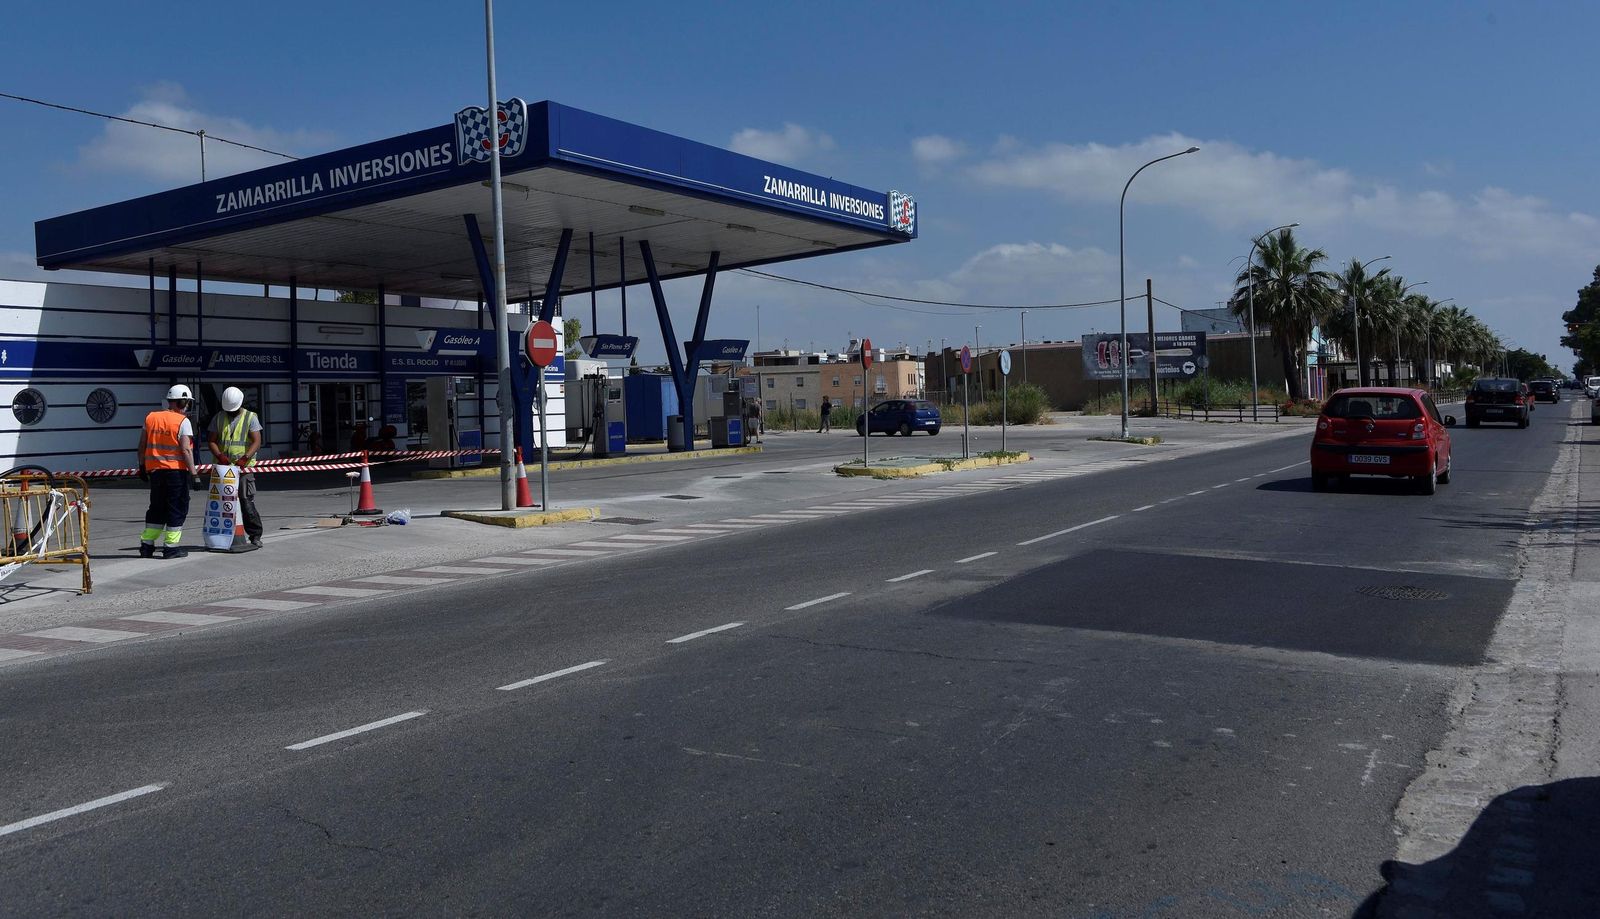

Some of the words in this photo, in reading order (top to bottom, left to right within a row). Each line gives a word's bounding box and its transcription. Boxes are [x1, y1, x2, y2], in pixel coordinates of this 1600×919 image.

[216, 172, 323, 213] ZAMARRILLA
[330, 142, 453, 189] INVERSIONES
[764, 175, 827, 207] ZAMARRILLA
[830, 192, 884, 220] INVERSIONES
[443, 335, 473, 345] Gasóleo
[474, 337, 481, 345] A
[196, 356, 203, 364] A
[224, 354, 271, 363] INVERSIONES
[306, 352, 358, 369] Tienda
[416, 358, 439, 366] ROCIO
[1354, 455, 1371, 463] 0039
[1375, 455, 1387, 463] GVS
